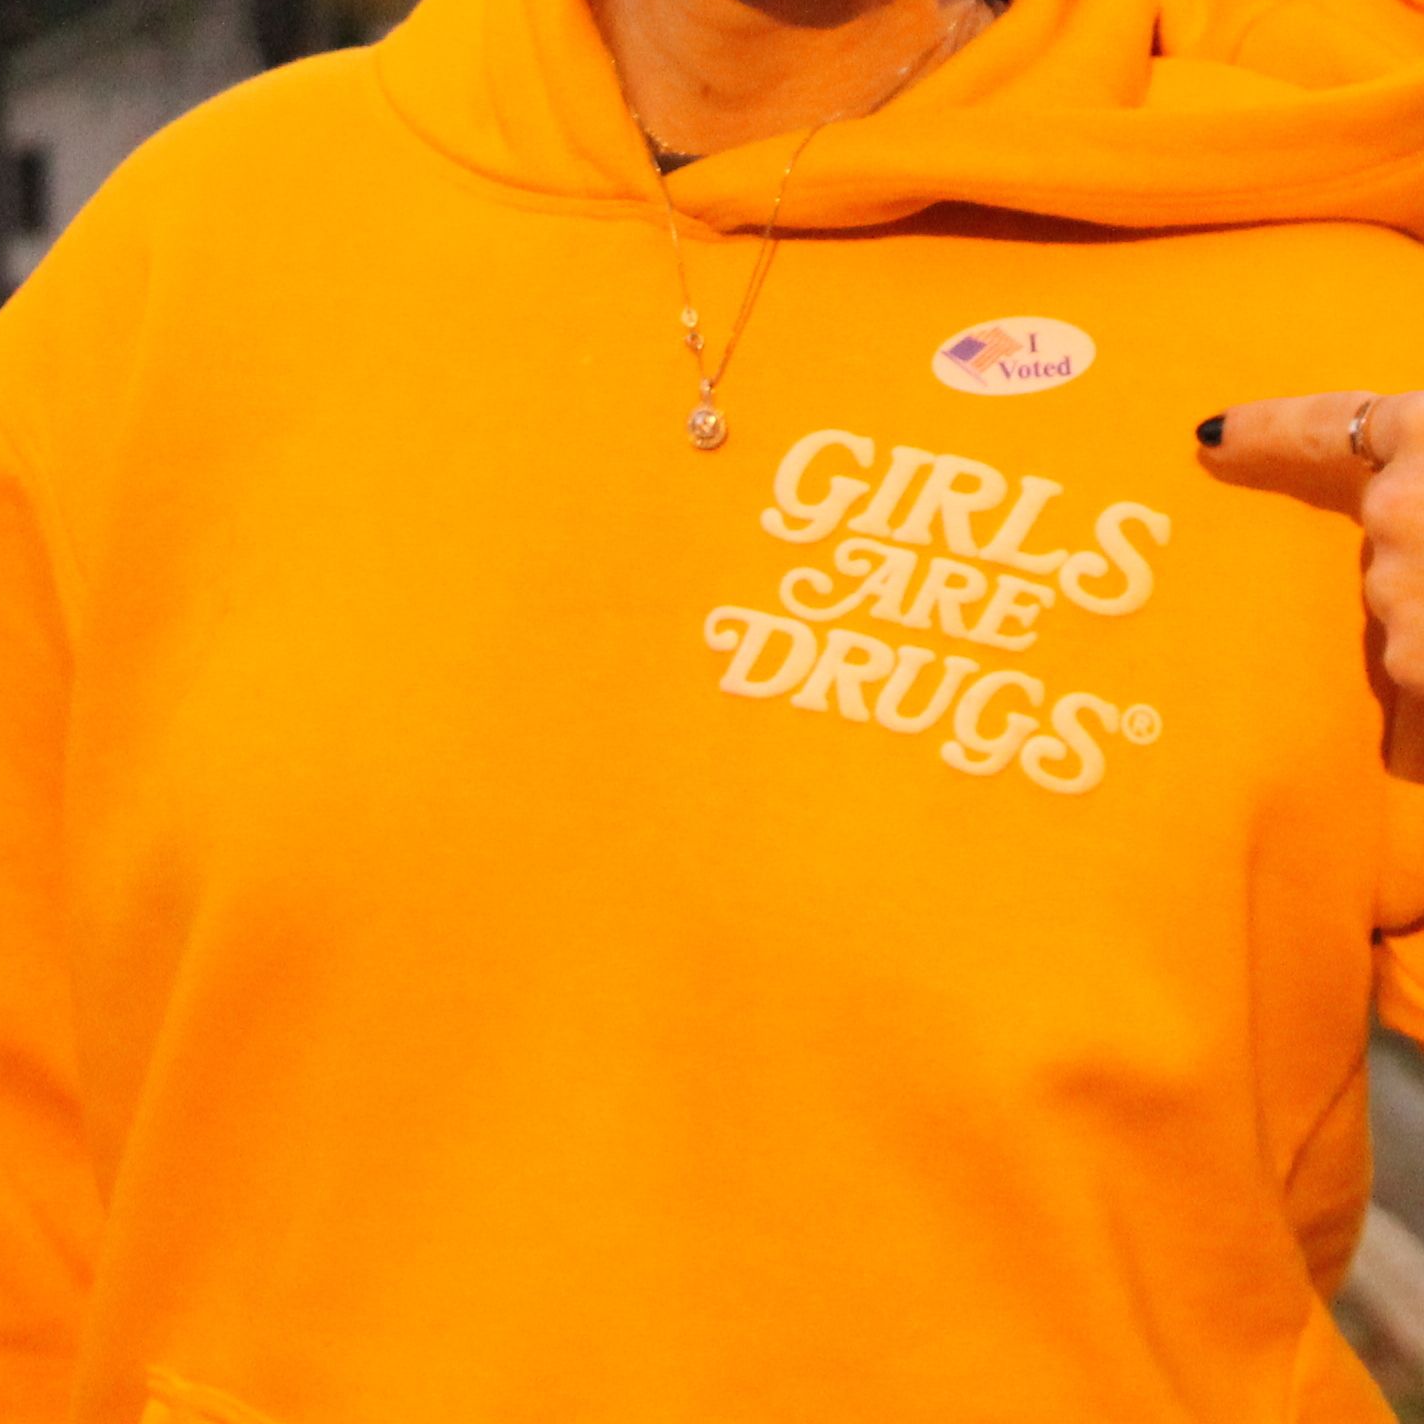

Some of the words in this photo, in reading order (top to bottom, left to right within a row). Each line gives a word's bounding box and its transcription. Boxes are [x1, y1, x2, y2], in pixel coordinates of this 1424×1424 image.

[999, 356, 1072, 381] Voted
[1028, 332, 1039, 354] I
[761, 429, 1170, 615] GIRLS
[779, 538, 1056, 651] ARE
